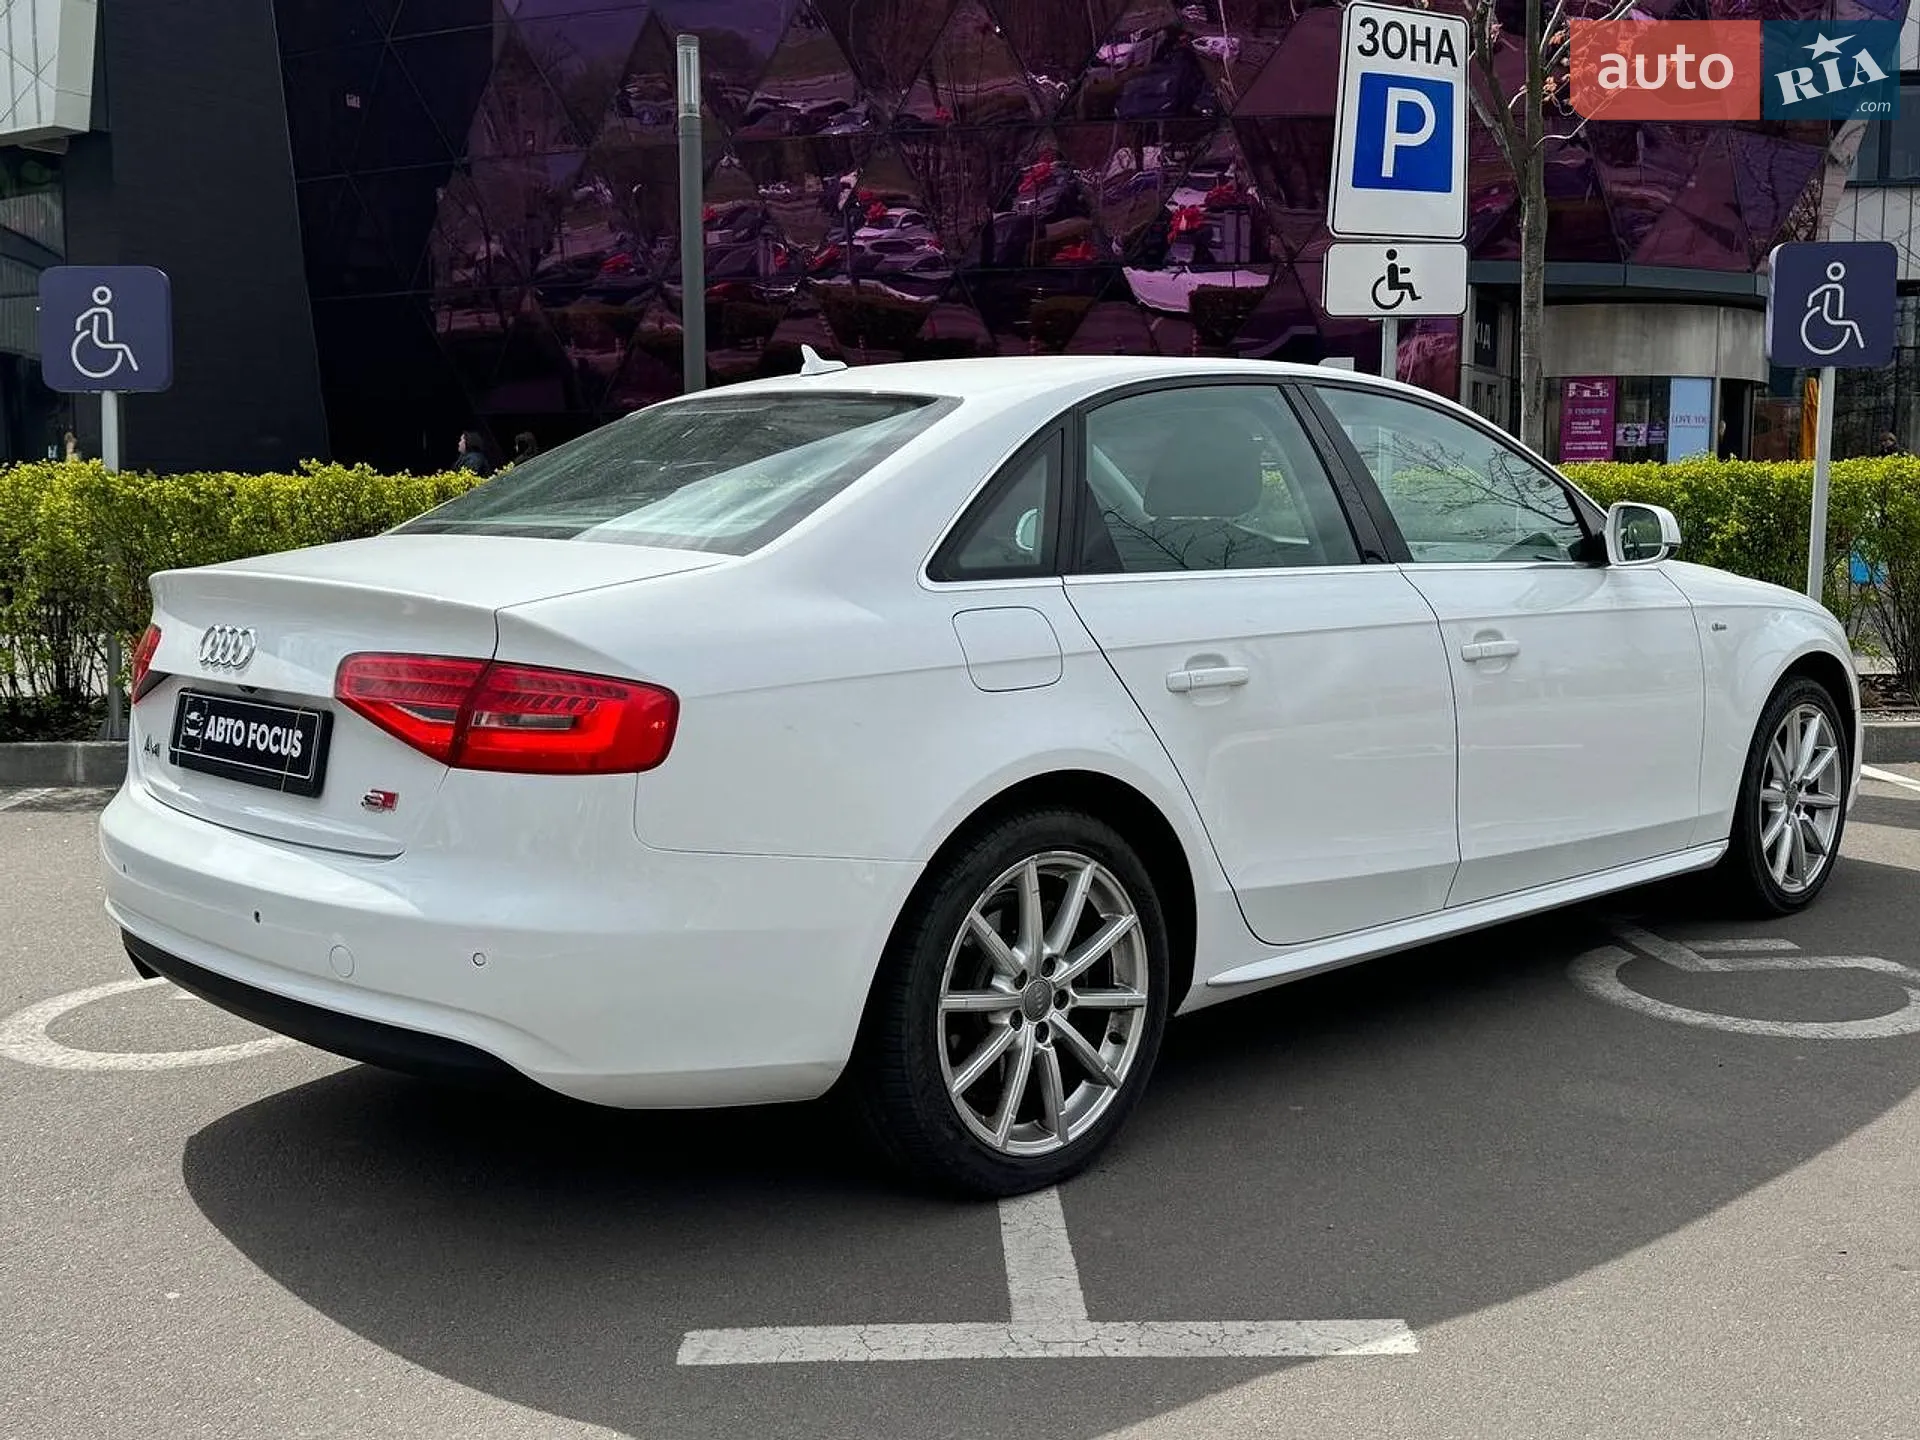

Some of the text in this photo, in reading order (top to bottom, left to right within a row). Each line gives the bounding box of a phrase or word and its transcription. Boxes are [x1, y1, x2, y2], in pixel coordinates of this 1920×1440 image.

[1357, 16, 1458, 68] ЗОНА
[1381, 87, 1436, 178] P
[247, 722, 303, 758] FOCUS
